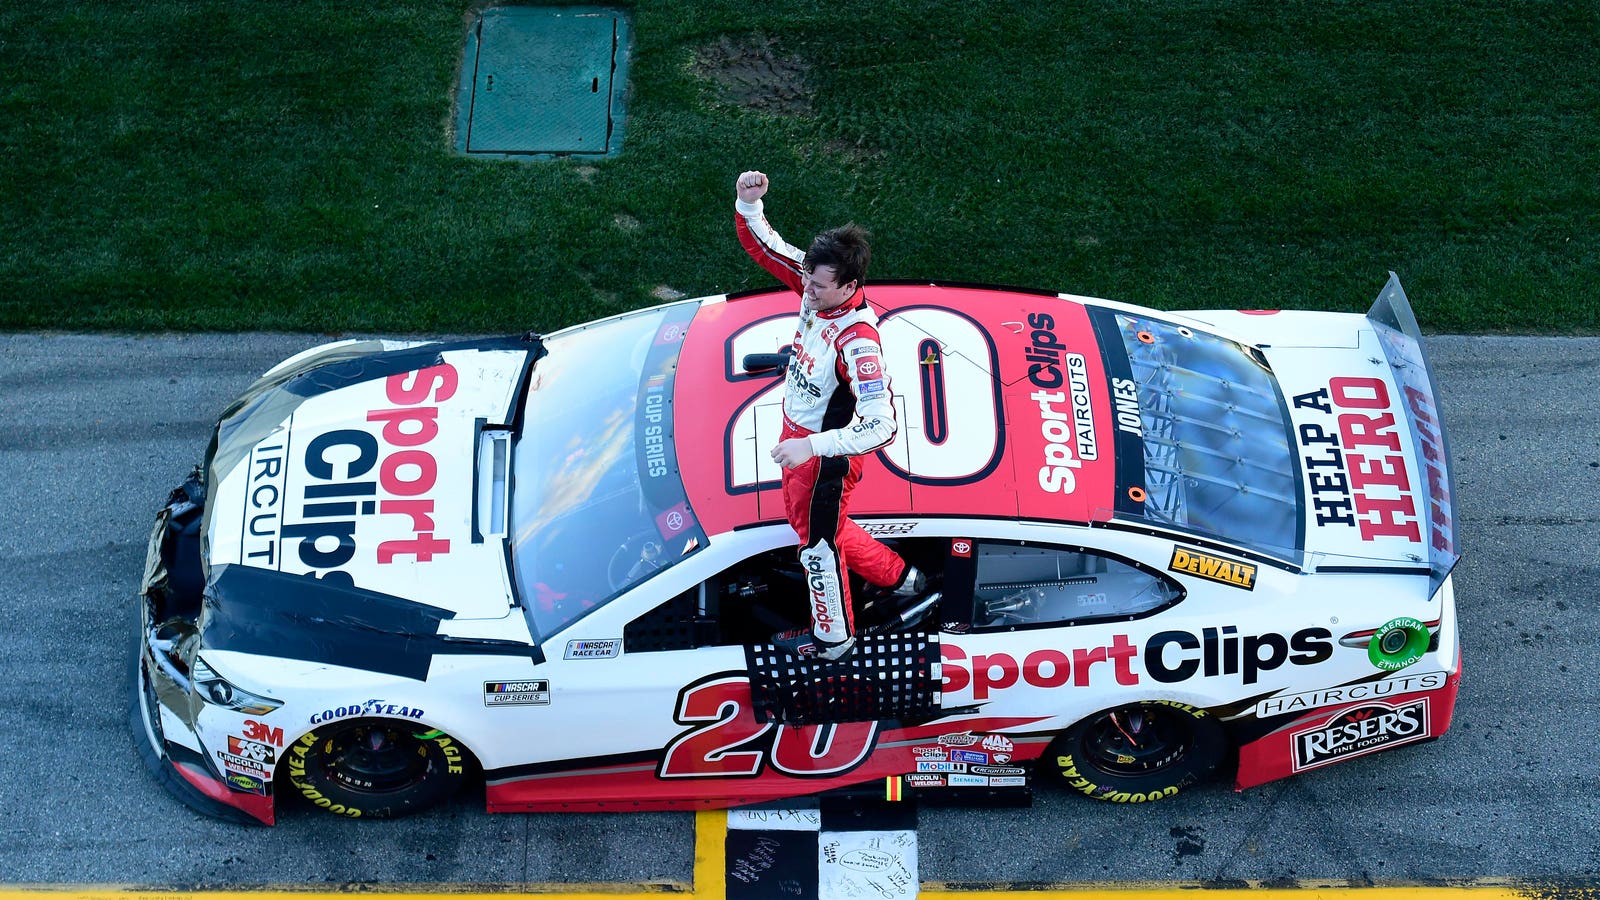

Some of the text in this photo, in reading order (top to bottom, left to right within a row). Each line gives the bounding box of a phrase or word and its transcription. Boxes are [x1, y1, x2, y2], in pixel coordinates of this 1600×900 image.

[1069, 356, 1094, 456] HAIRCUTS
[1112, 377, 1143, 438] JONES
[645, 395, 667, 478] CUP SERIES
[366, 363, 459, 564] Sport
[1293, 388, 1356, 527] HELP A
[1329, 377, 1422, 542] HERO
[248, 444, 284, 565] IRCUT
[583, 641, 614, 649] NASCAR
[1376, 619, 1423, 640] AMERICAN
[1377, 655, 1421, 669] ETHANOL
[494, 693, 540, 702] CUP SERIES
[505, 682, 540, 692] NASCAR
[1264, 675, 1439, 714] HAIRCUTS
[310, 700, 425, 724] GOODYEAR
[654, 669, 878, 780] 20
[242, 719, 284, 747] 3M
[982, 735, 1013, 747] MAC
[1303, 706, 1420, 764] RESER'S
[1333, 735, 1389, 755] FINE FOODS
[218, 752, 264, 771] LINCOLN
[228, 761, 267, 778] WELDERS
[289, 732, 362, 818] GOODYEAR
[920, 762, 951, 771] Mobil
[1057, 754, 1178, 803] GOODYEAR
